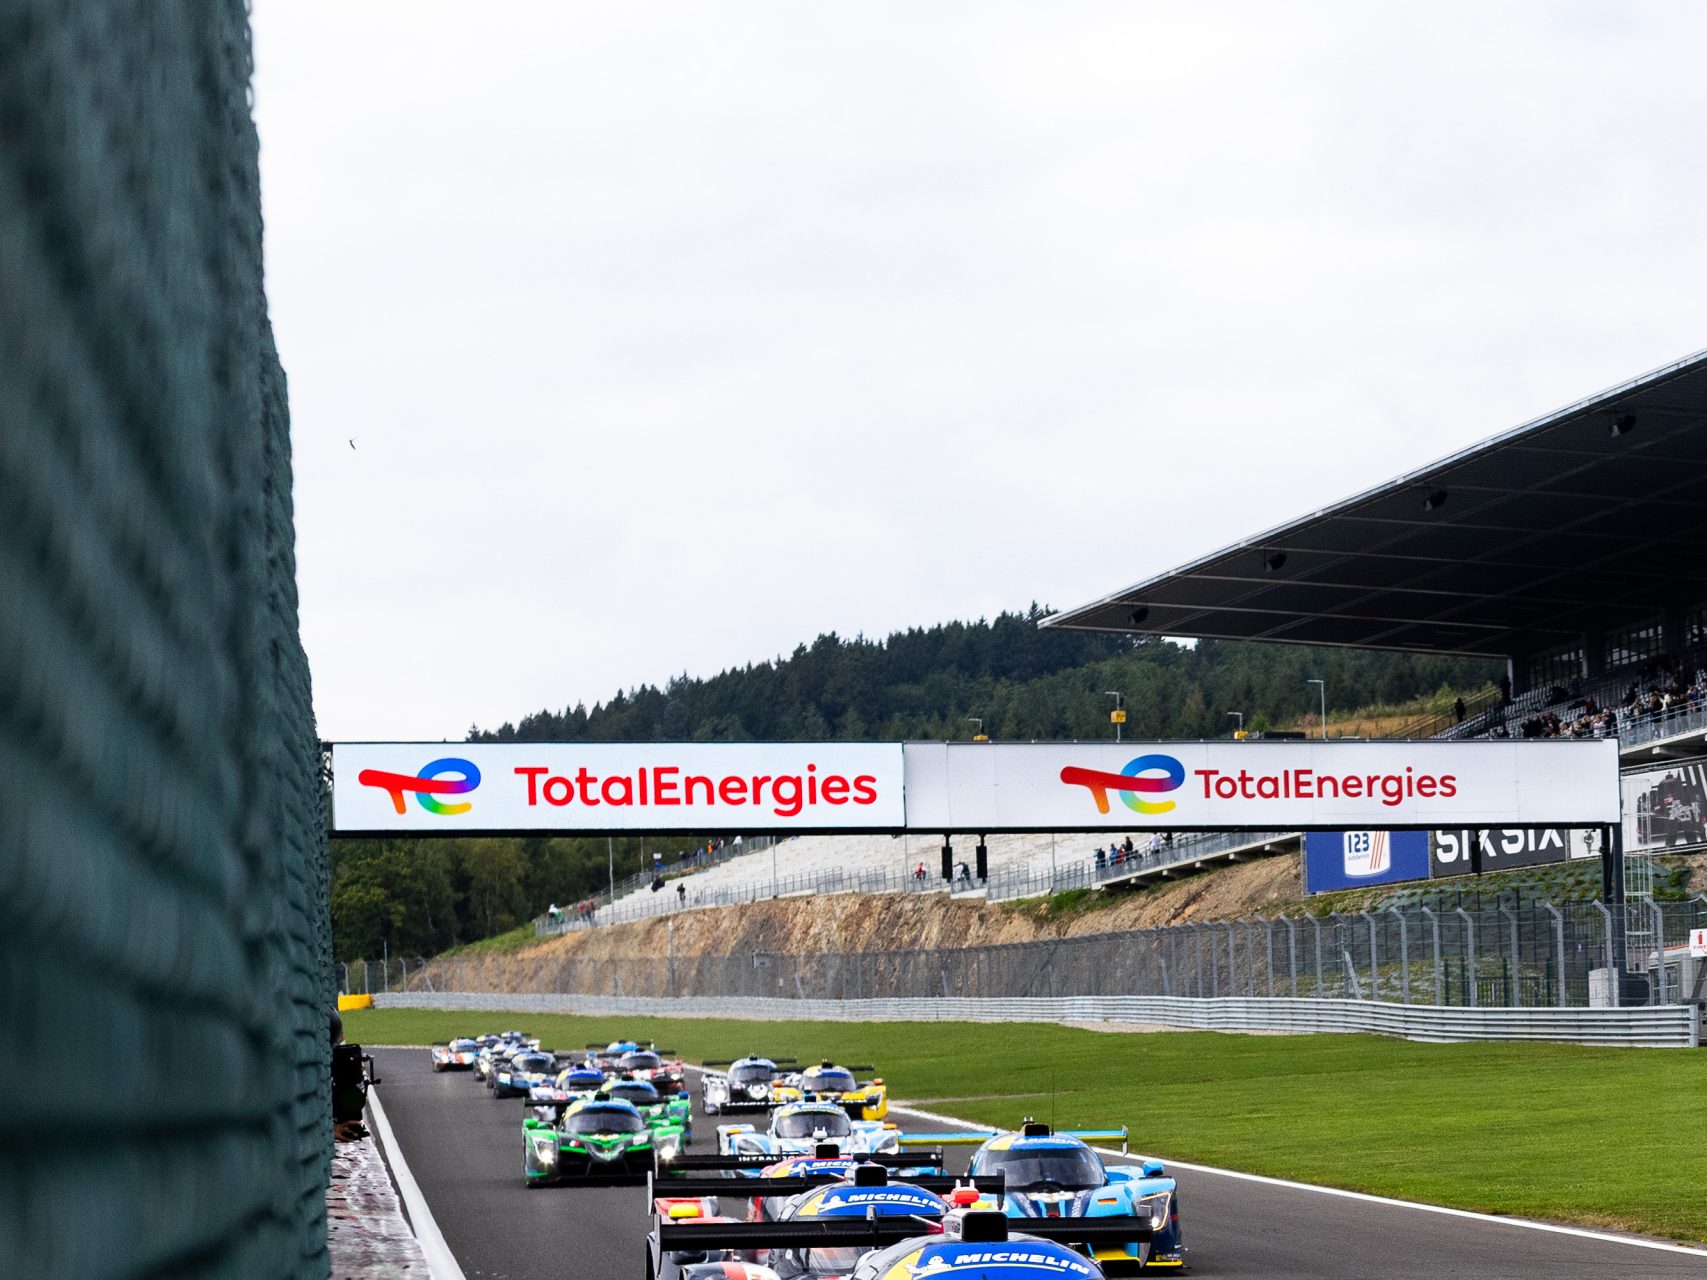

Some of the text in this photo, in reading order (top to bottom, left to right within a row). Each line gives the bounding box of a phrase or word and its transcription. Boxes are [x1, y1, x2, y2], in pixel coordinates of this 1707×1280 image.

[514, 764, 877, 817] TotalEnergies
[1195, 767, 1457, 806] TotalEnergies
[1348, 832, 1370, 854] 123
[848, 1193, 943, 1209] MICHELIN
[954, 1253, 1089, 1275] MICHELIN
